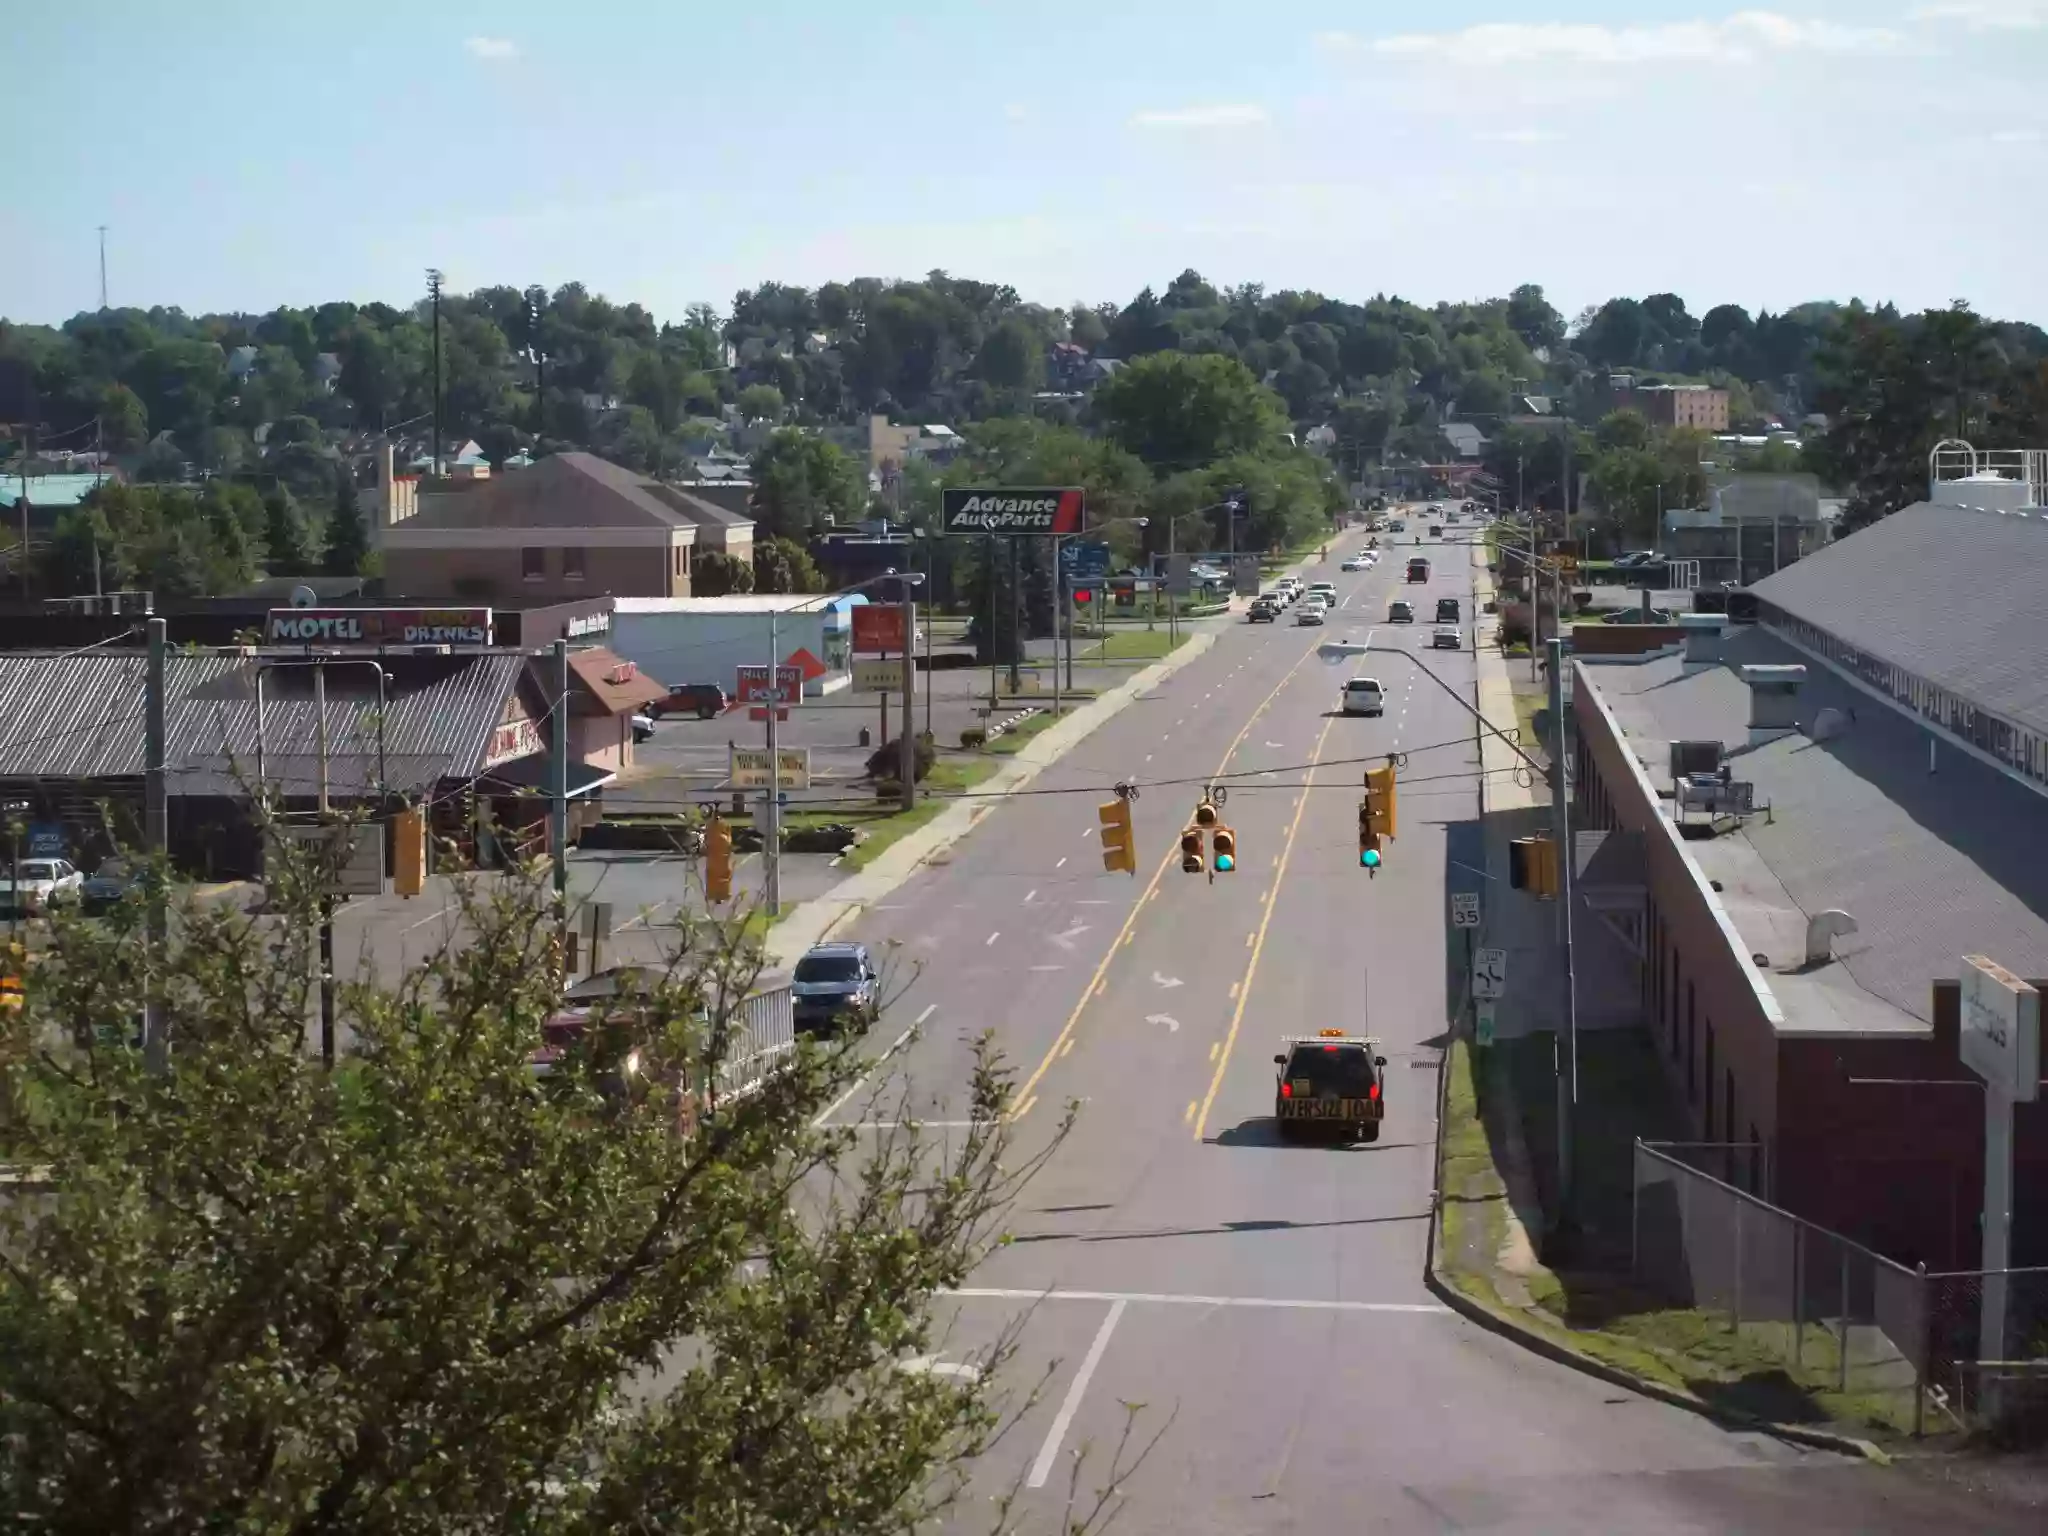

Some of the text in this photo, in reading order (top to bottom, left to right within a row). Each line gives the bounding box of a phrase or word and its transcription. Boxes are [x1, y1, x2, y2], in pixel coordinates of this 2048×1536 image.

[961, 496, 1058, 512] Advance
[951, 511, 1052, 526] AutoParts
[272, 618, 363, 639] MOTEL
[404, 626, 484, 642] DRINKS
[742, 669, 796, 682] Hitcing
[1455, 911, 1478, 924] 35
